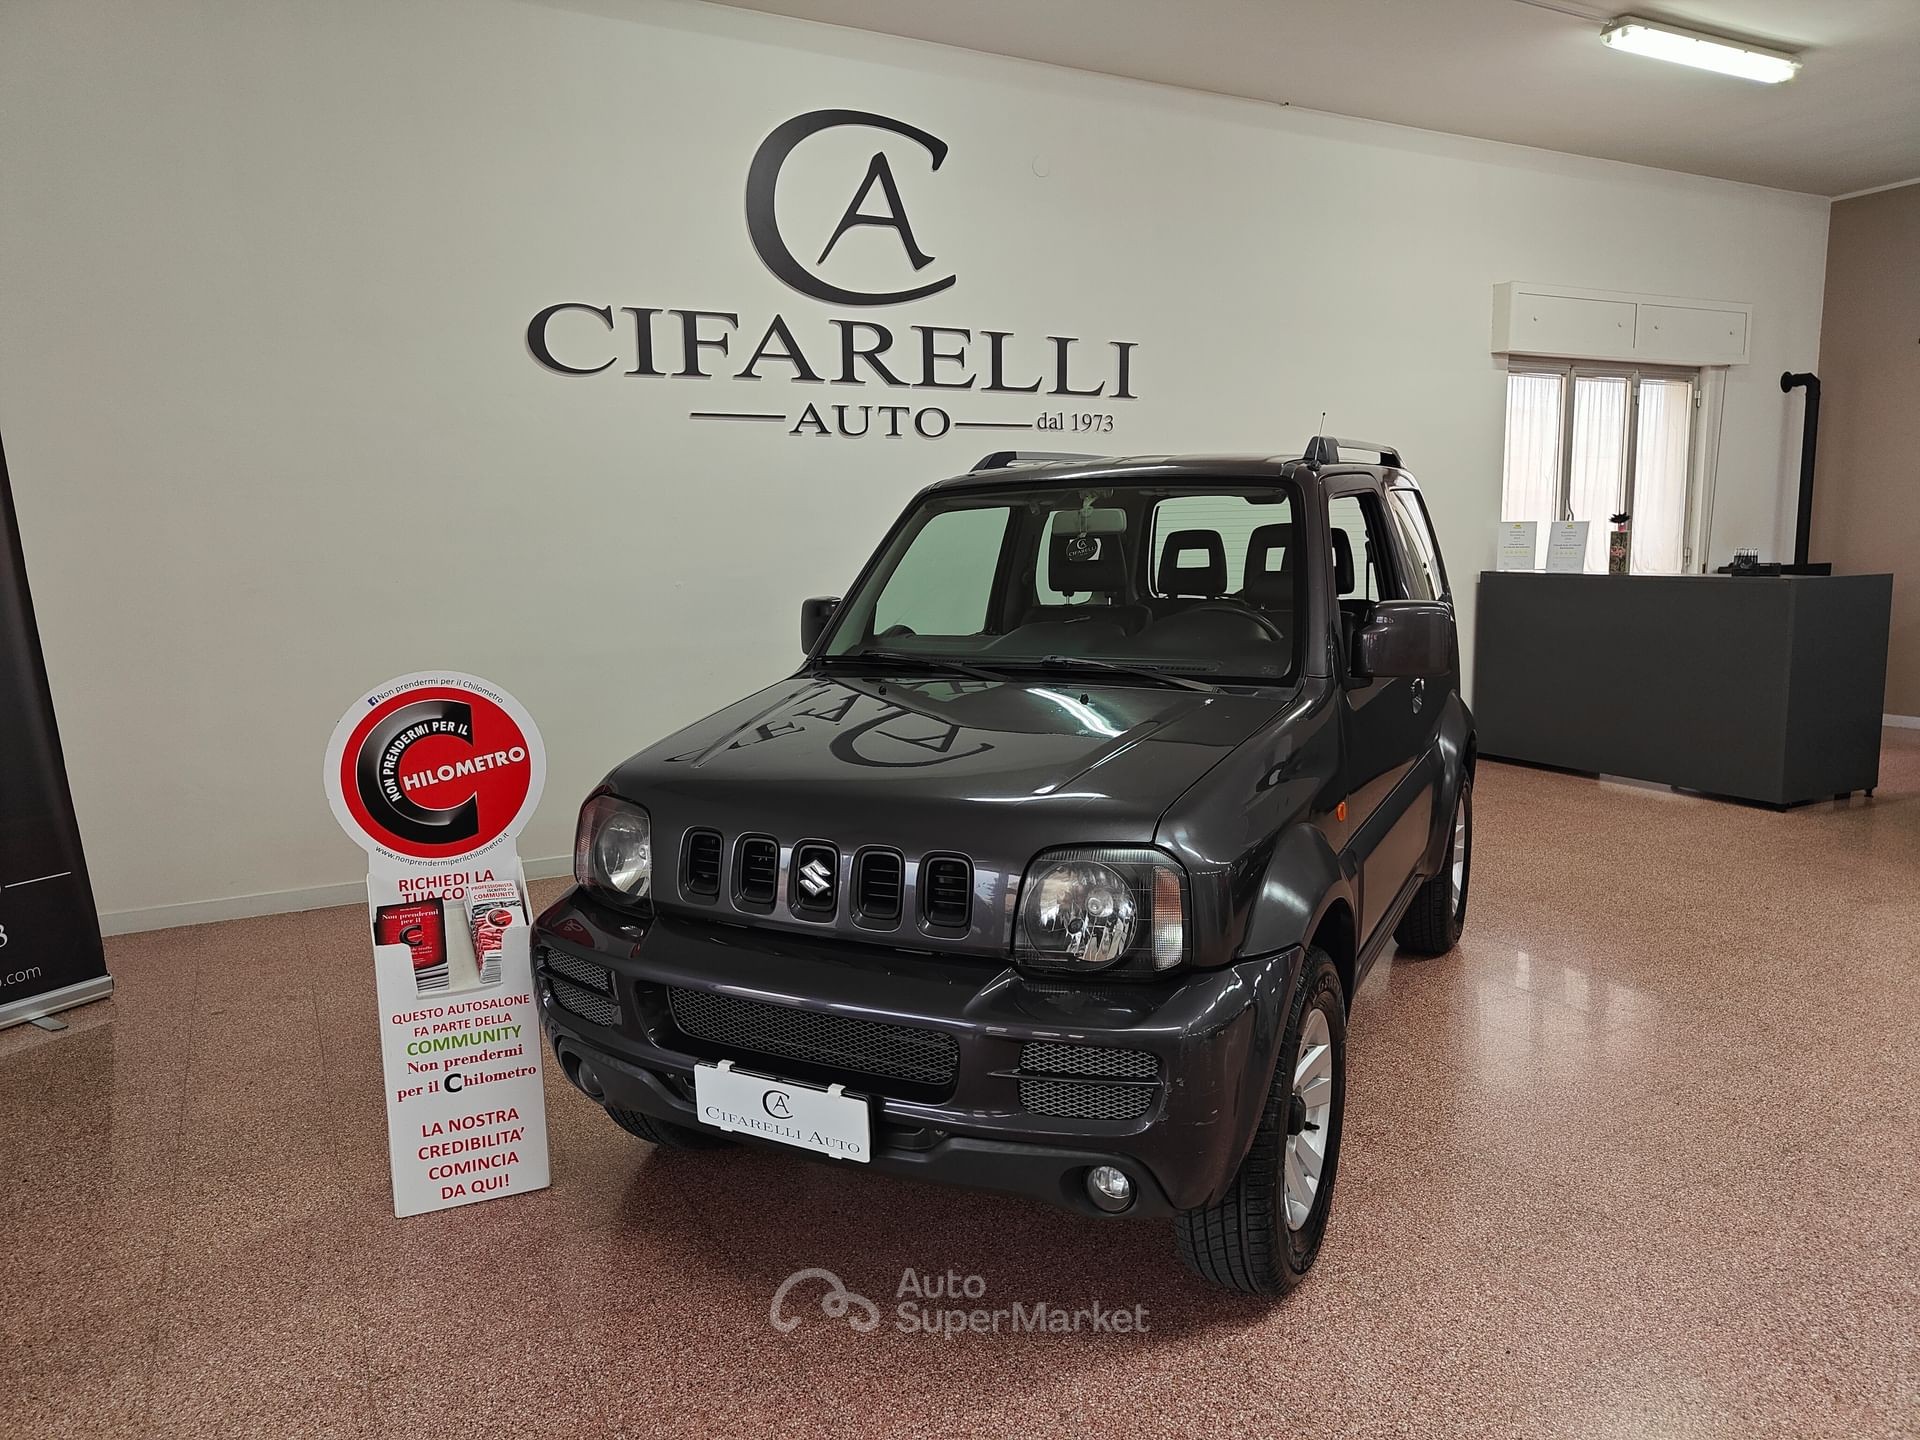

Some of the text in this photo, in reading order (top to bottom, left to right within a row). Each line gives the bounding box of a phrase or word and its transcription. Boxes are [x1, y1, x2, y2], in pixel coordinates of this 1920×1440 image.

[526, 302, 1140, 400] CIFARELLI
[789, 403, 1115, 438] AUTO dal 1973
[377, 678, 505, 704] Non prendermi per il Chilometro
[382, 721, 468, 802] NON PRENDERMI PER IL
[375, 832, 510, 867] www.nonprendermiperilchilometro.it
[399, 869, 494, 892] RICHIEDI LA
[400, 909, 439, 920] prendermi
[0, 966, 42, 987] .com
[392, 994, 530, 1025] QUESTO AUTOSALONE
[414, 1012, 512, 1038] FA PARTE DELLA
[406, 1025, 522, 1056] COMMUNITY
[407, 1043, 524, 1075] Non prendermi
[397, 1064, 537, 1102] per il Chilometro
[421, 1107, 520, 1138] LA NOSTRA
[428, 1151, 520, 1181] COMINCIA
[441, 1173, 510, 1200] DA QUI!
